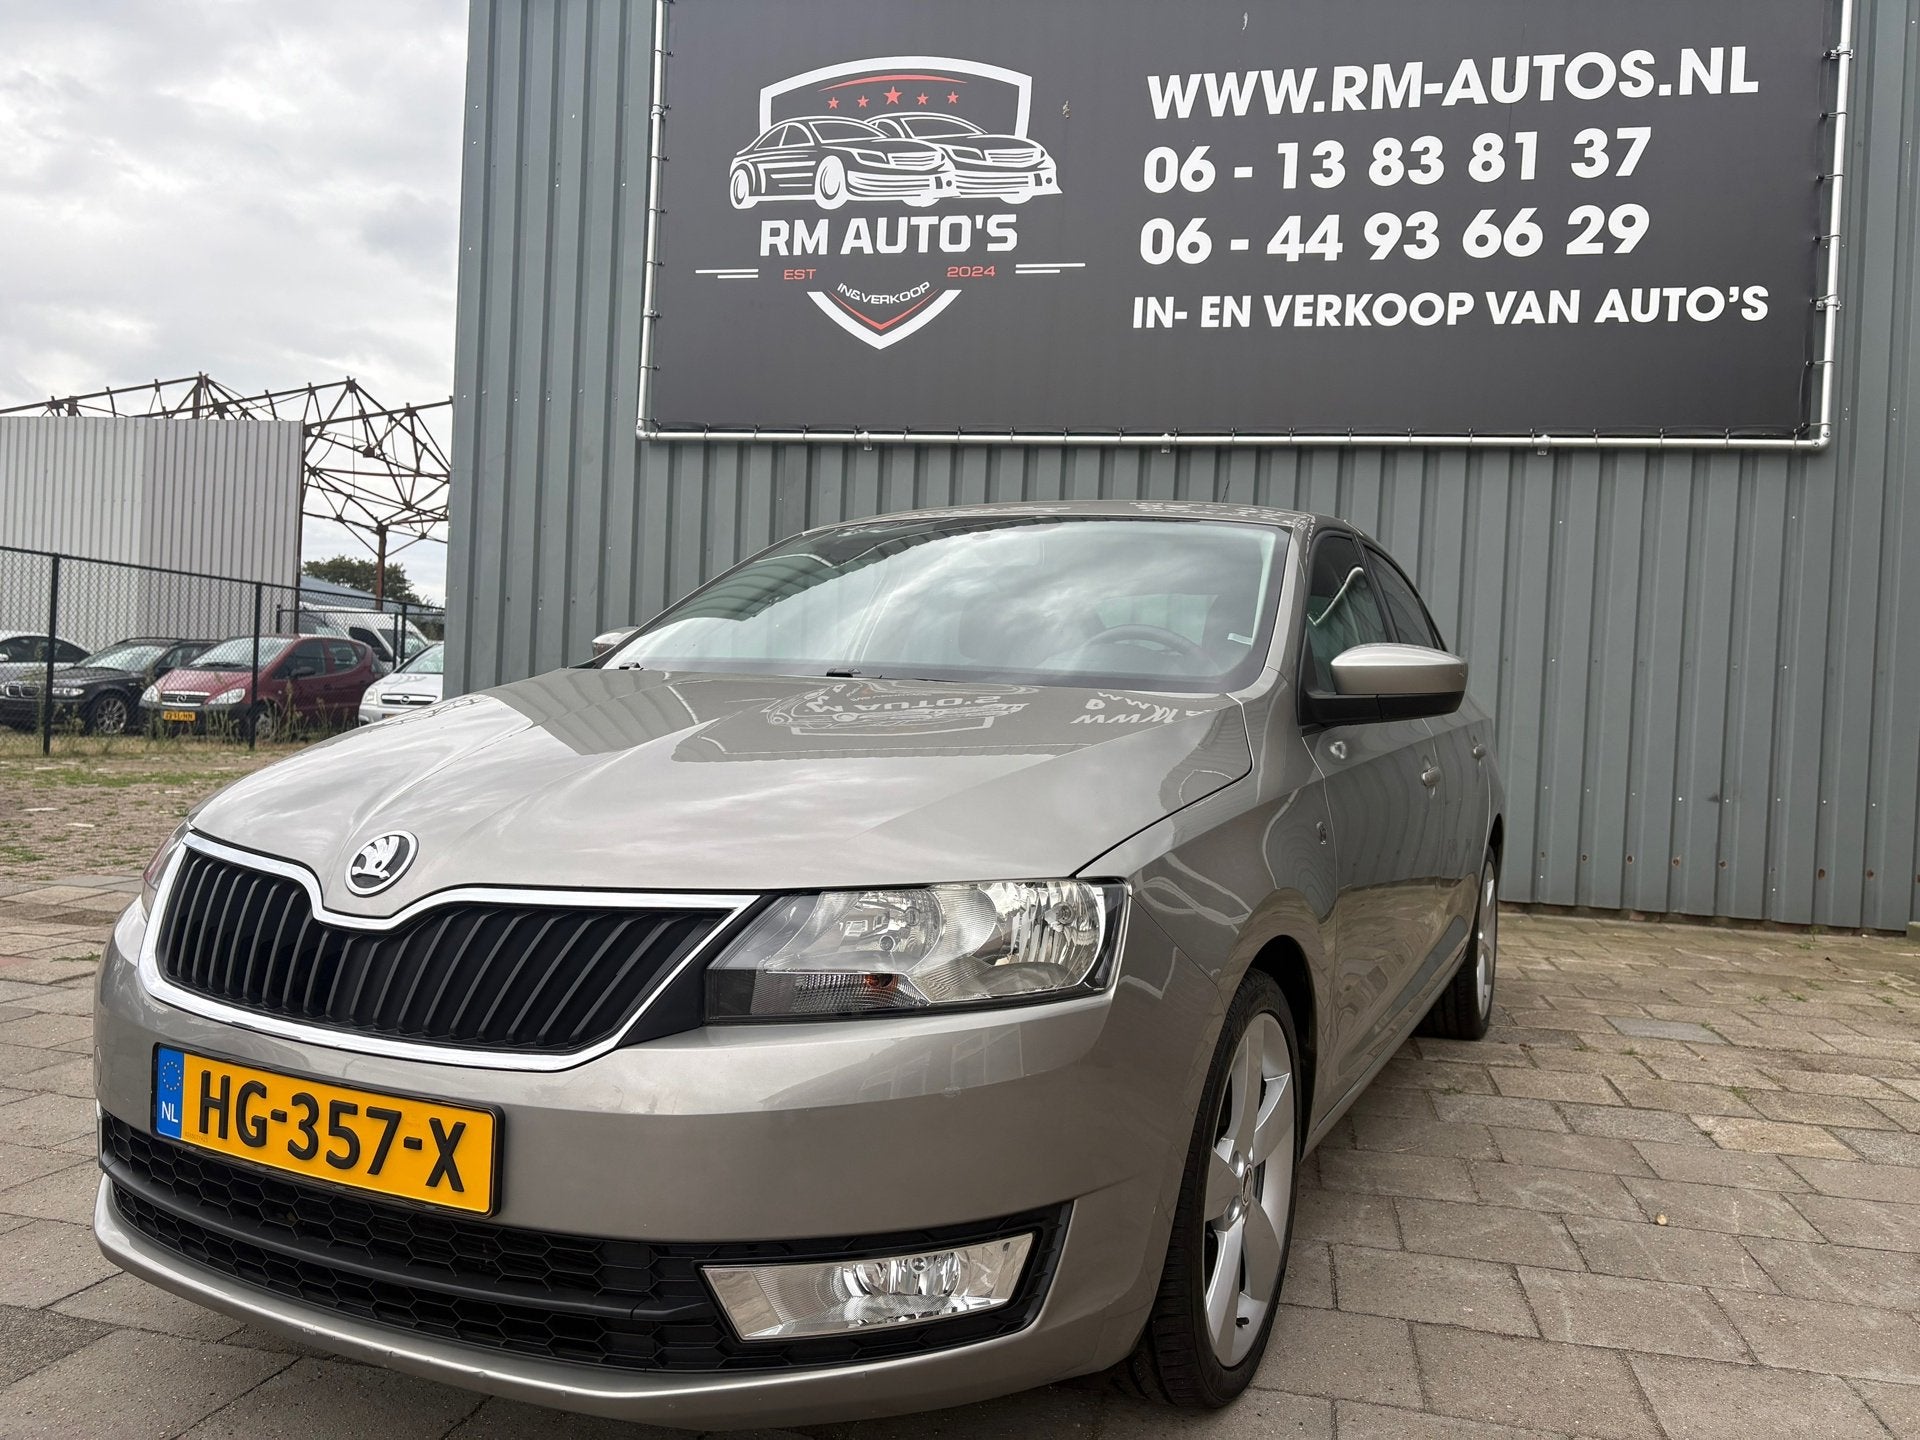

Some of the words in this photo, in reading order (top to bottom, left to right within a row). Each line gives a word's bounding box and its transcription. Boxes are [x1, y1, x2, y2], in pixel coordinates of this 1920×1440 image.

[1146, 45, 1759, 120] WWW.RM-AUTOS.NL
[1143, 145, 1216, 194] 06
[1233, 166, 1254, 179] -
[1277, 139, 1346, 190] 13
[1368, 135, 1445, 187] 83
[1468, 131, 1538, 183] 81
[1570, 126, 1652, 179] 37
[759, 218, 829, 257] RM
[839, 213, 1018, 255] AUTO'S
[1139, 217, 1213, 266] 06
[1229, 238, 1250, 251] -
[1266, 214, 1344, 263] 44
[1363, 210, 1440, 261] 93
[1462, 207, 1544, 259] 66
[1565, 203, 1650, 256] 29
[783, 269, 816, 280] EST
[947, 265, 996, 278] 2024
[1132, 296, 1188, 329] IN-
[1200, 295, 1252, 328] EN
[1263, 291, 1475, 328] VERKOOP
[1485, 289, 1581, 325] VAN
[161, 1101, 179, 1123] NL
[199, 1069, 467, 1193] HG-357-X
